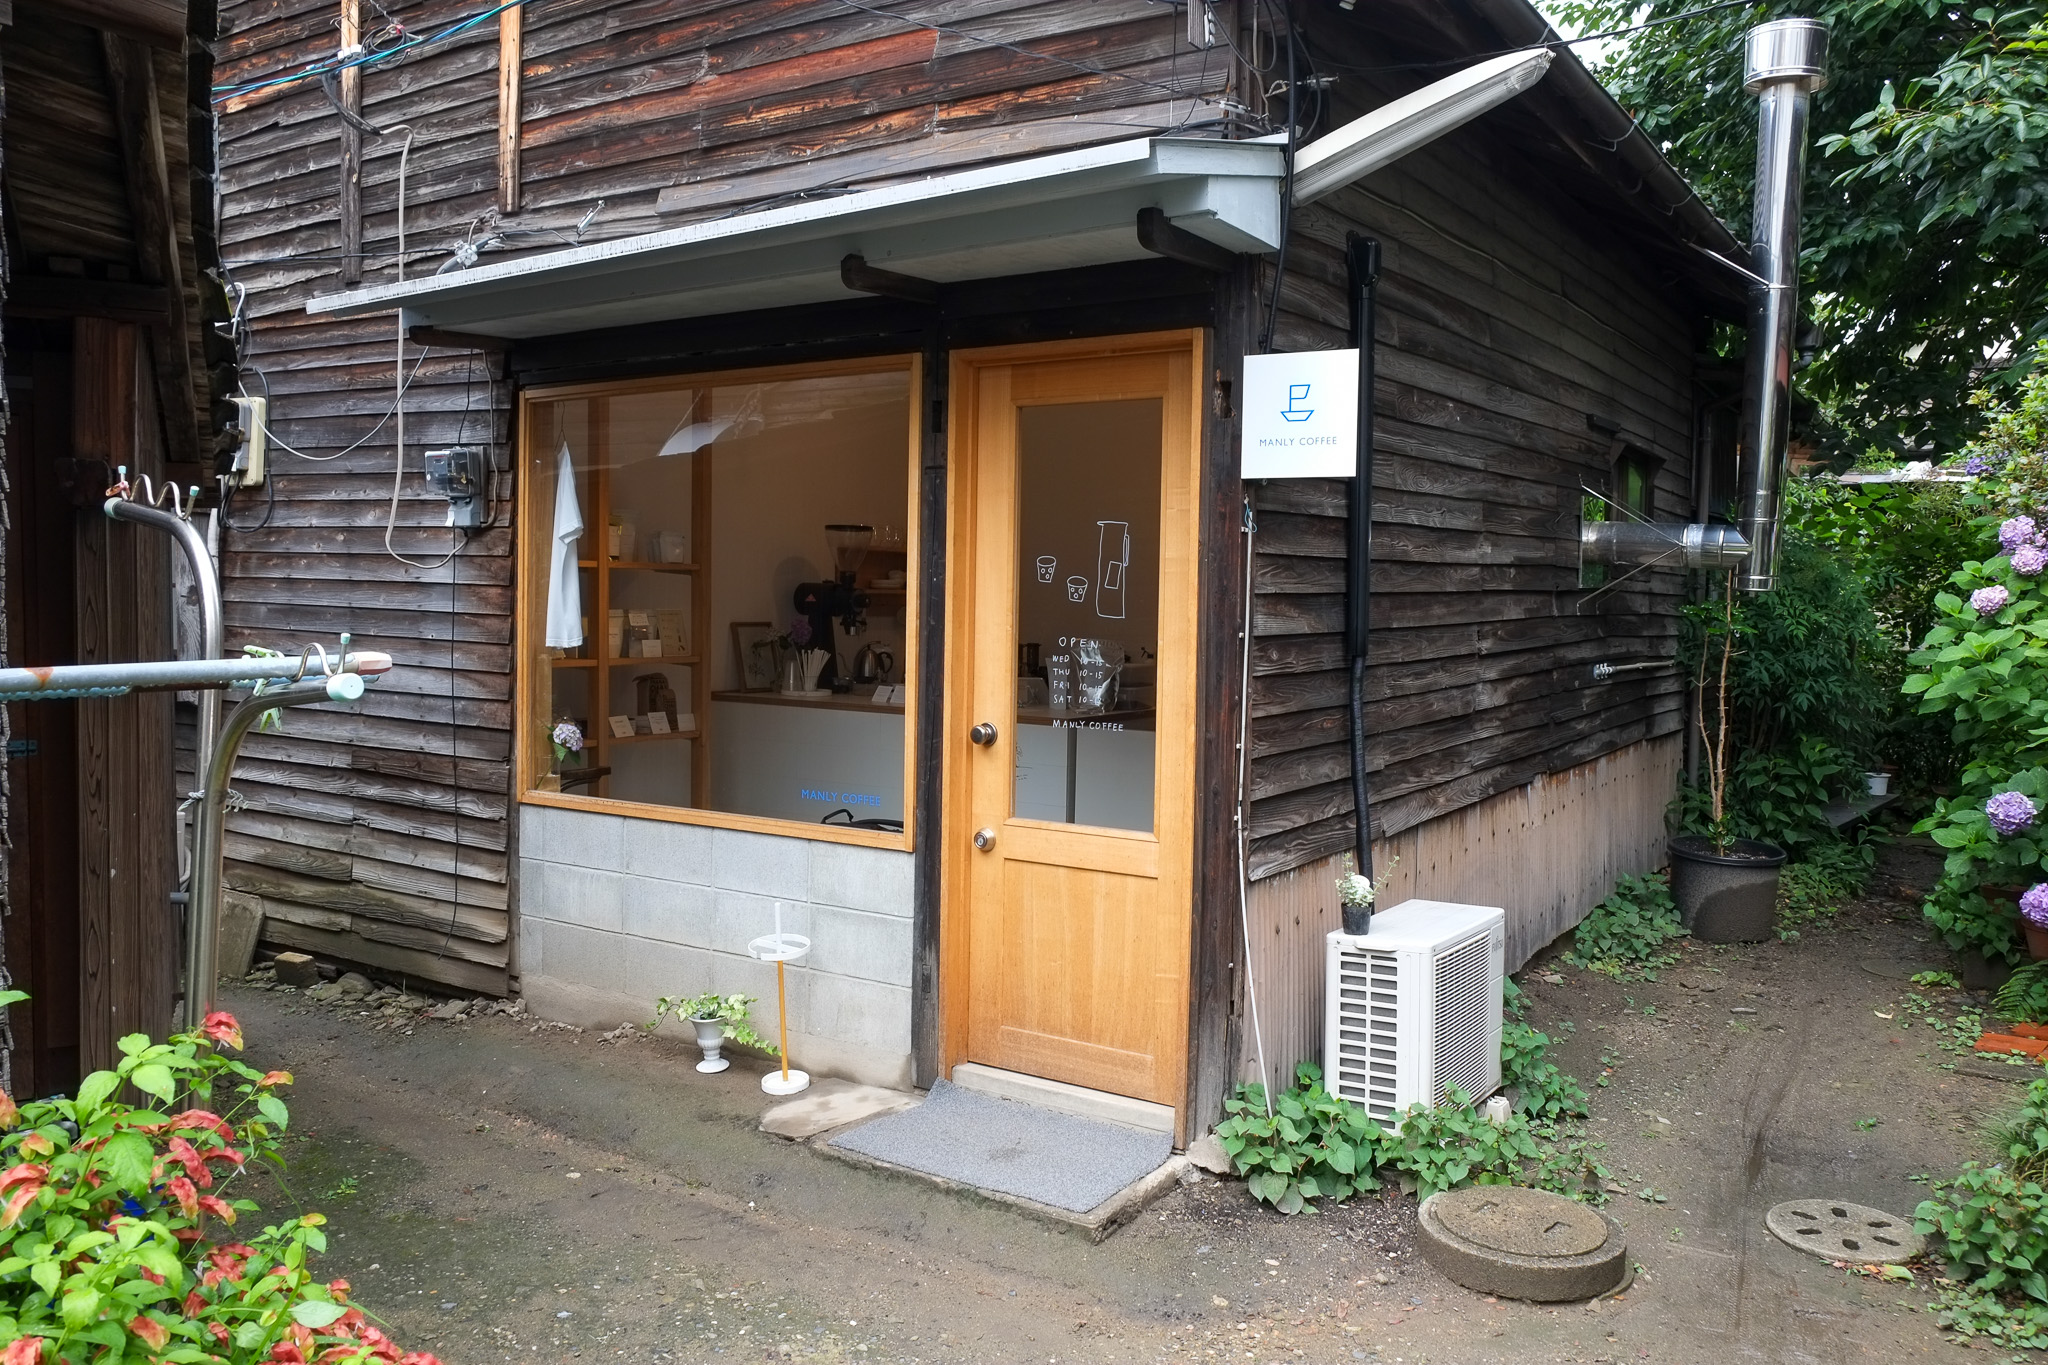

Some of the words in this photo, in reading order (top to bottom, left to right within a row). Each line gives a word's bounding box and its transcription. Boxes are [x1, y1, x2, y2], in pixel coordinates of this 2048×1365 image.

[1259, 438, 1295, 447] MANLY
[1299, 437, 1337, 446] COFFEE
[1058, 636, 1099, 649] OPEN
[1052, 654, 1070, 663] WED
[1052, 668, 1071, 676] THU
[1053, 680, 1070, 690] FRI
[1053, 694, 1072, 704] SAT
[1052, 719, 1086, 730] MANLY
[1089, 721, 1124, 732] COFFEE
[801, 789, 838, 802] MANLY
[841, 793, 881, 806] COFFEE
